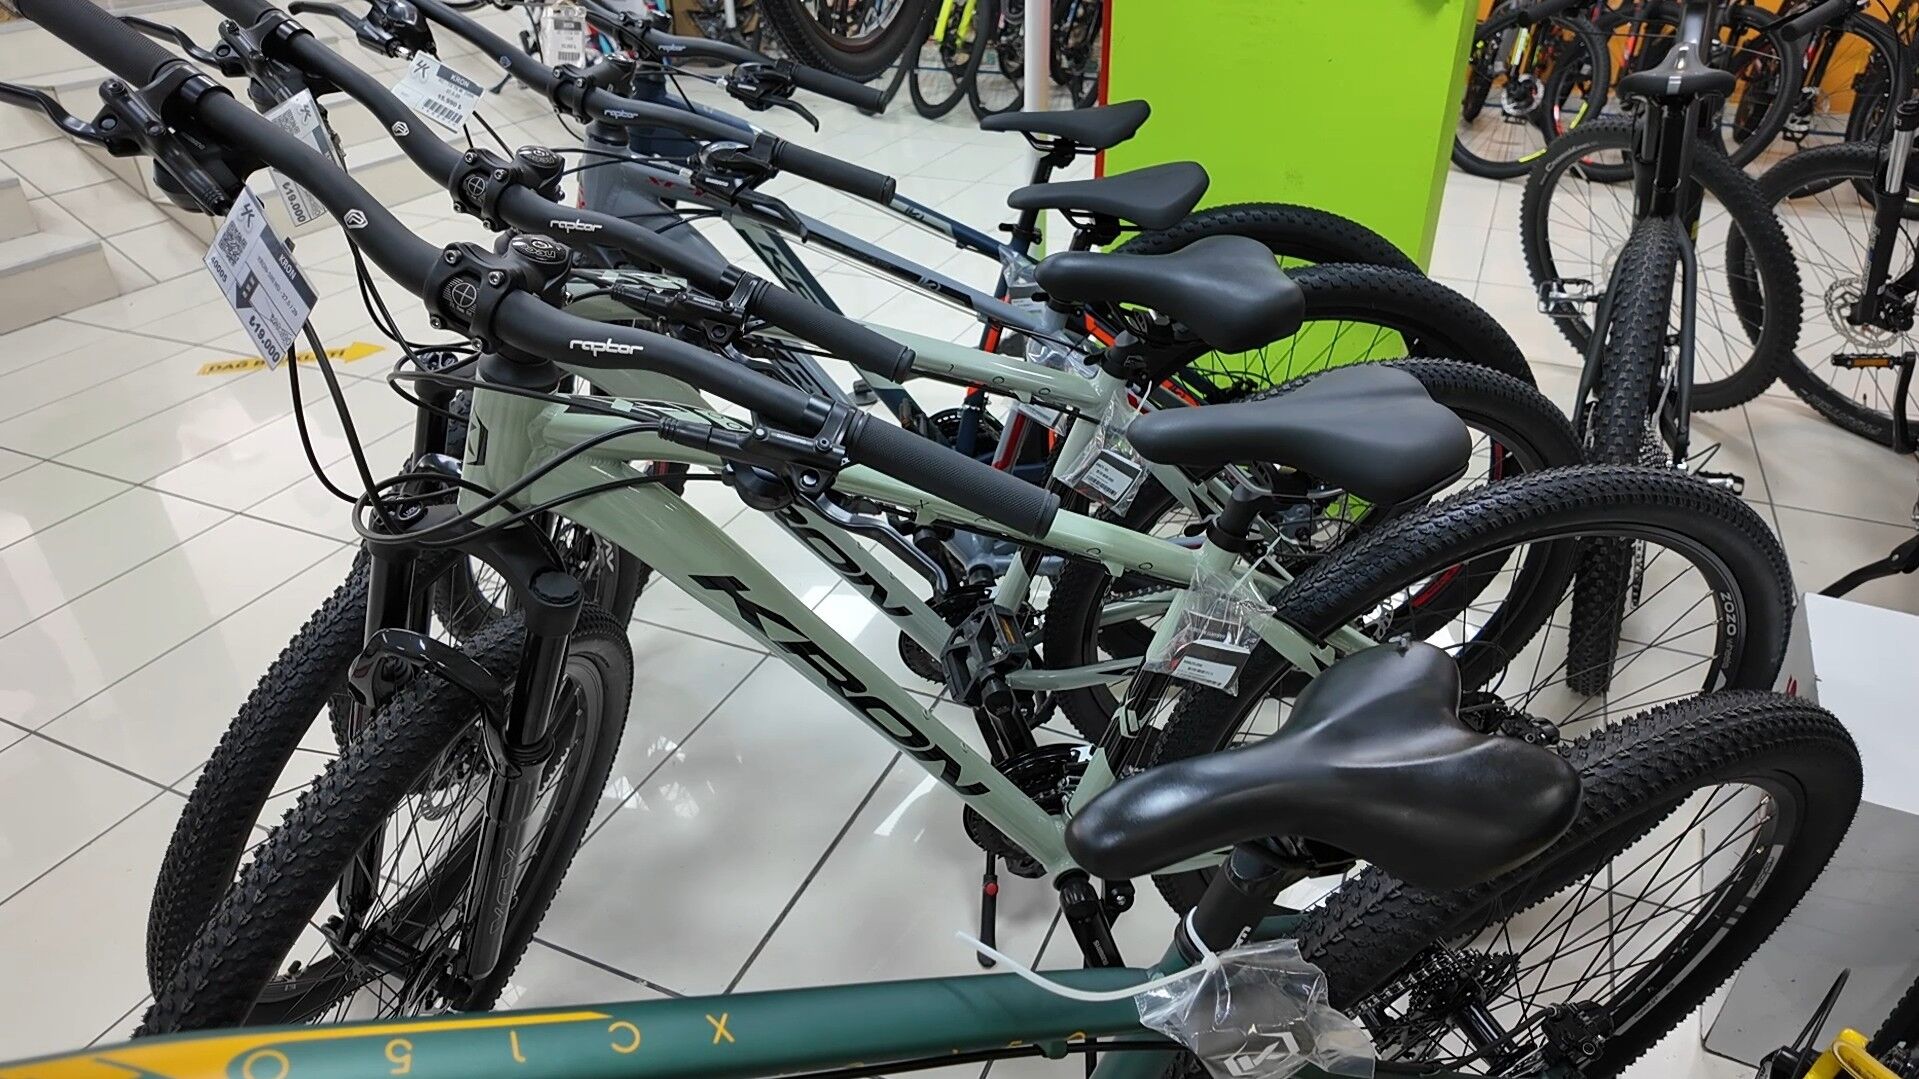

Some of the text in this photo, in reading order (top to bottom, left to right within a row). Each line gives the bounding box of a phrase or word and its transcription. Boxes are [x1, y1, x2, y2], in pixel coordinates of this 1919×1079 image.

[450, 74, 470, 88] KRON
[604, 109, 639, 119] raptor
[550, 219, 602, 233] raptor
[278, 253, 297, 281] KRON
[248, 315, 280, 363] ₺19.000
[569, 338, 644, 357] raptor
[1720, 591, 1737, 636] ZOZO
[688, 574, 991, 796] KRON
